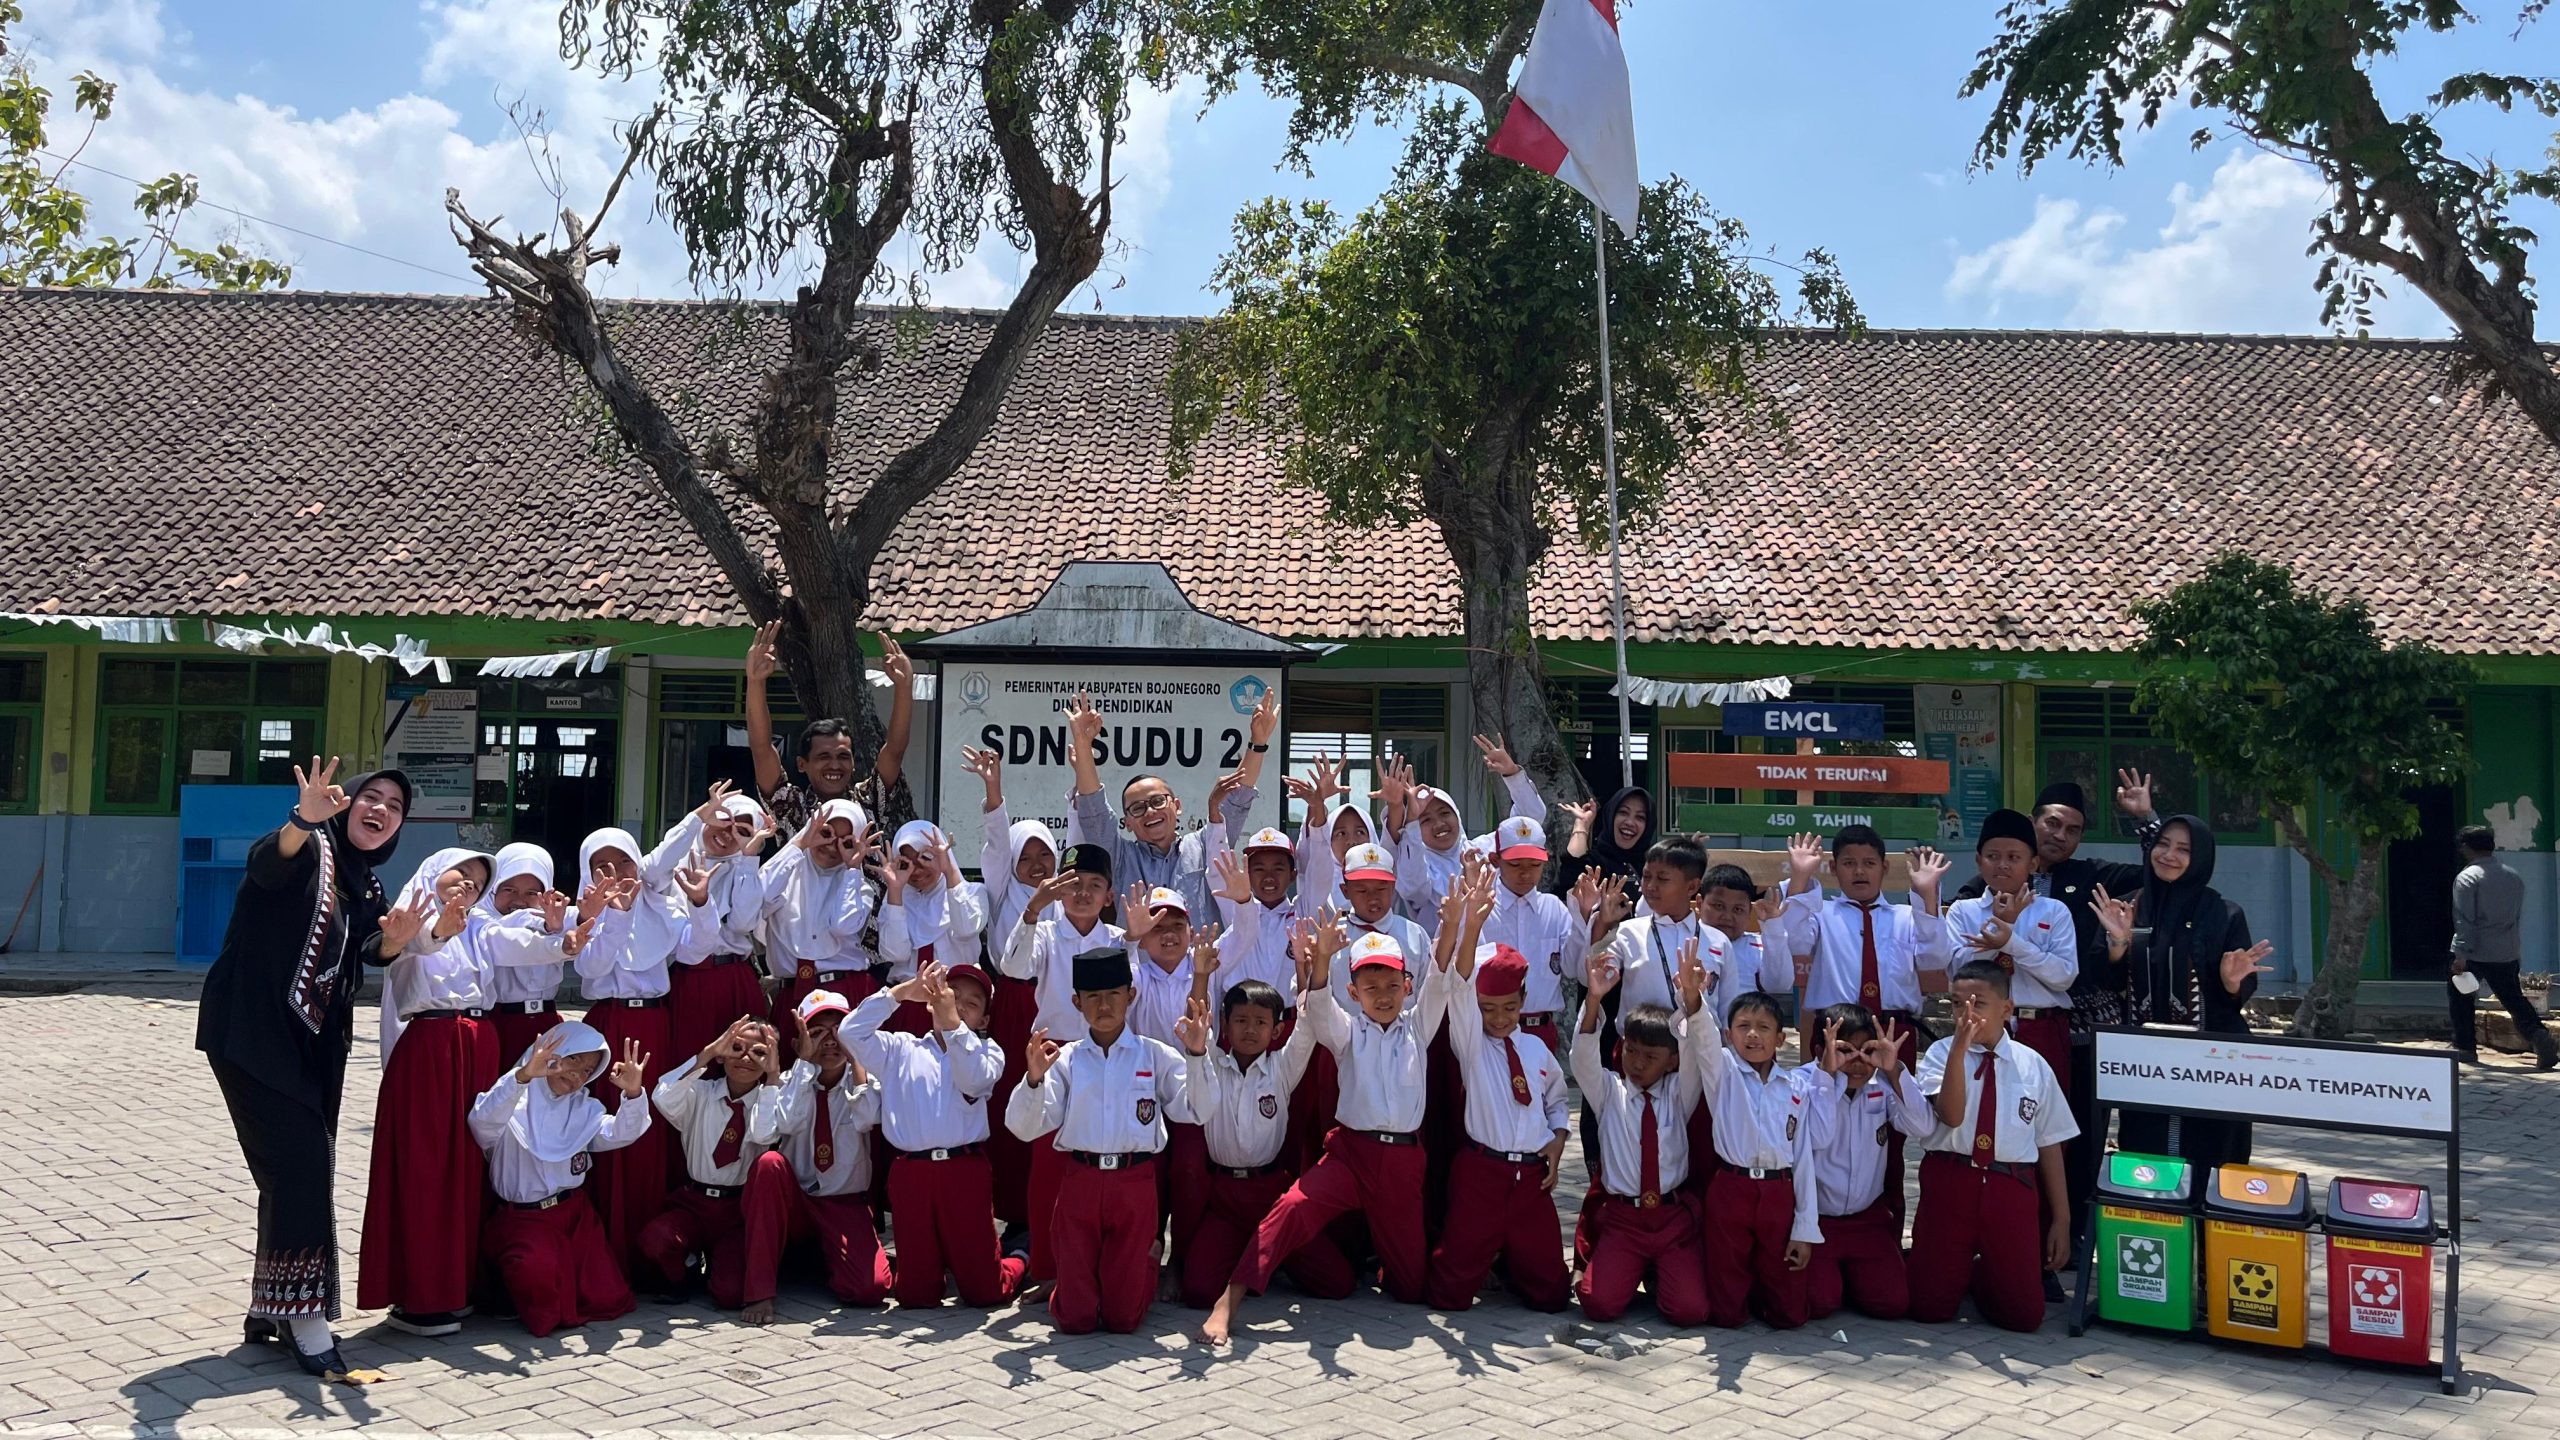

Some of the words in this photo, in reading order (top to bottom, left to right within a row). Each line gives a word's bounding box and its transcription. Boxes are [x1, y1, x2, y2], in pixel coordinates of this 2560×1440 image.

[1005, 681, 1074, 693] PEMERINTAH
[1079, 682, 1142, 694] KABUPATEN
[1147, 683, 1221, 695] BOJONEGORO
[1095, 699, 1172, 713] PENDIDIKAN
[1929, 709, 1935, 721] 7
[1936, 708, 1986, 721] KEBIASAAN
[1764, 710, 1838, 733] EMCL
[1936, 722, 1955, 732] ANAK
[1957, 722, 1980, 732] HEBAT
[980, 724, 1066, 766] SDN
[1092, 727, 1203, 768] SUDU
[1220, 728, 1243, 768] 2
[1757, 765, 1807, 780] TIDAK
[1816, 767, 1887, 782] TERURAI
[1767, 813, 1795, 826] 450
[1812, 813, 1872, 828] TAHUN
[2099, 1061, 2166, 1080] SEMUA
[2170, 1067, 2253, 1087] SAMPAH
[2259, 1074, 2302, 1091] ADA
[2307, 1079, 2432, 1102] TEMPATNYA
[2122, 1275, 2162, 1286] SAMPAH
[2122, 1282, 2162, 1293] ORGANIK
[2233, 1300, 2273, 1312] SAMPAH
[2356, 1308, 2397, 1318] SAMPAH
[2358, 1315, 2395, 1325] RESIDU
